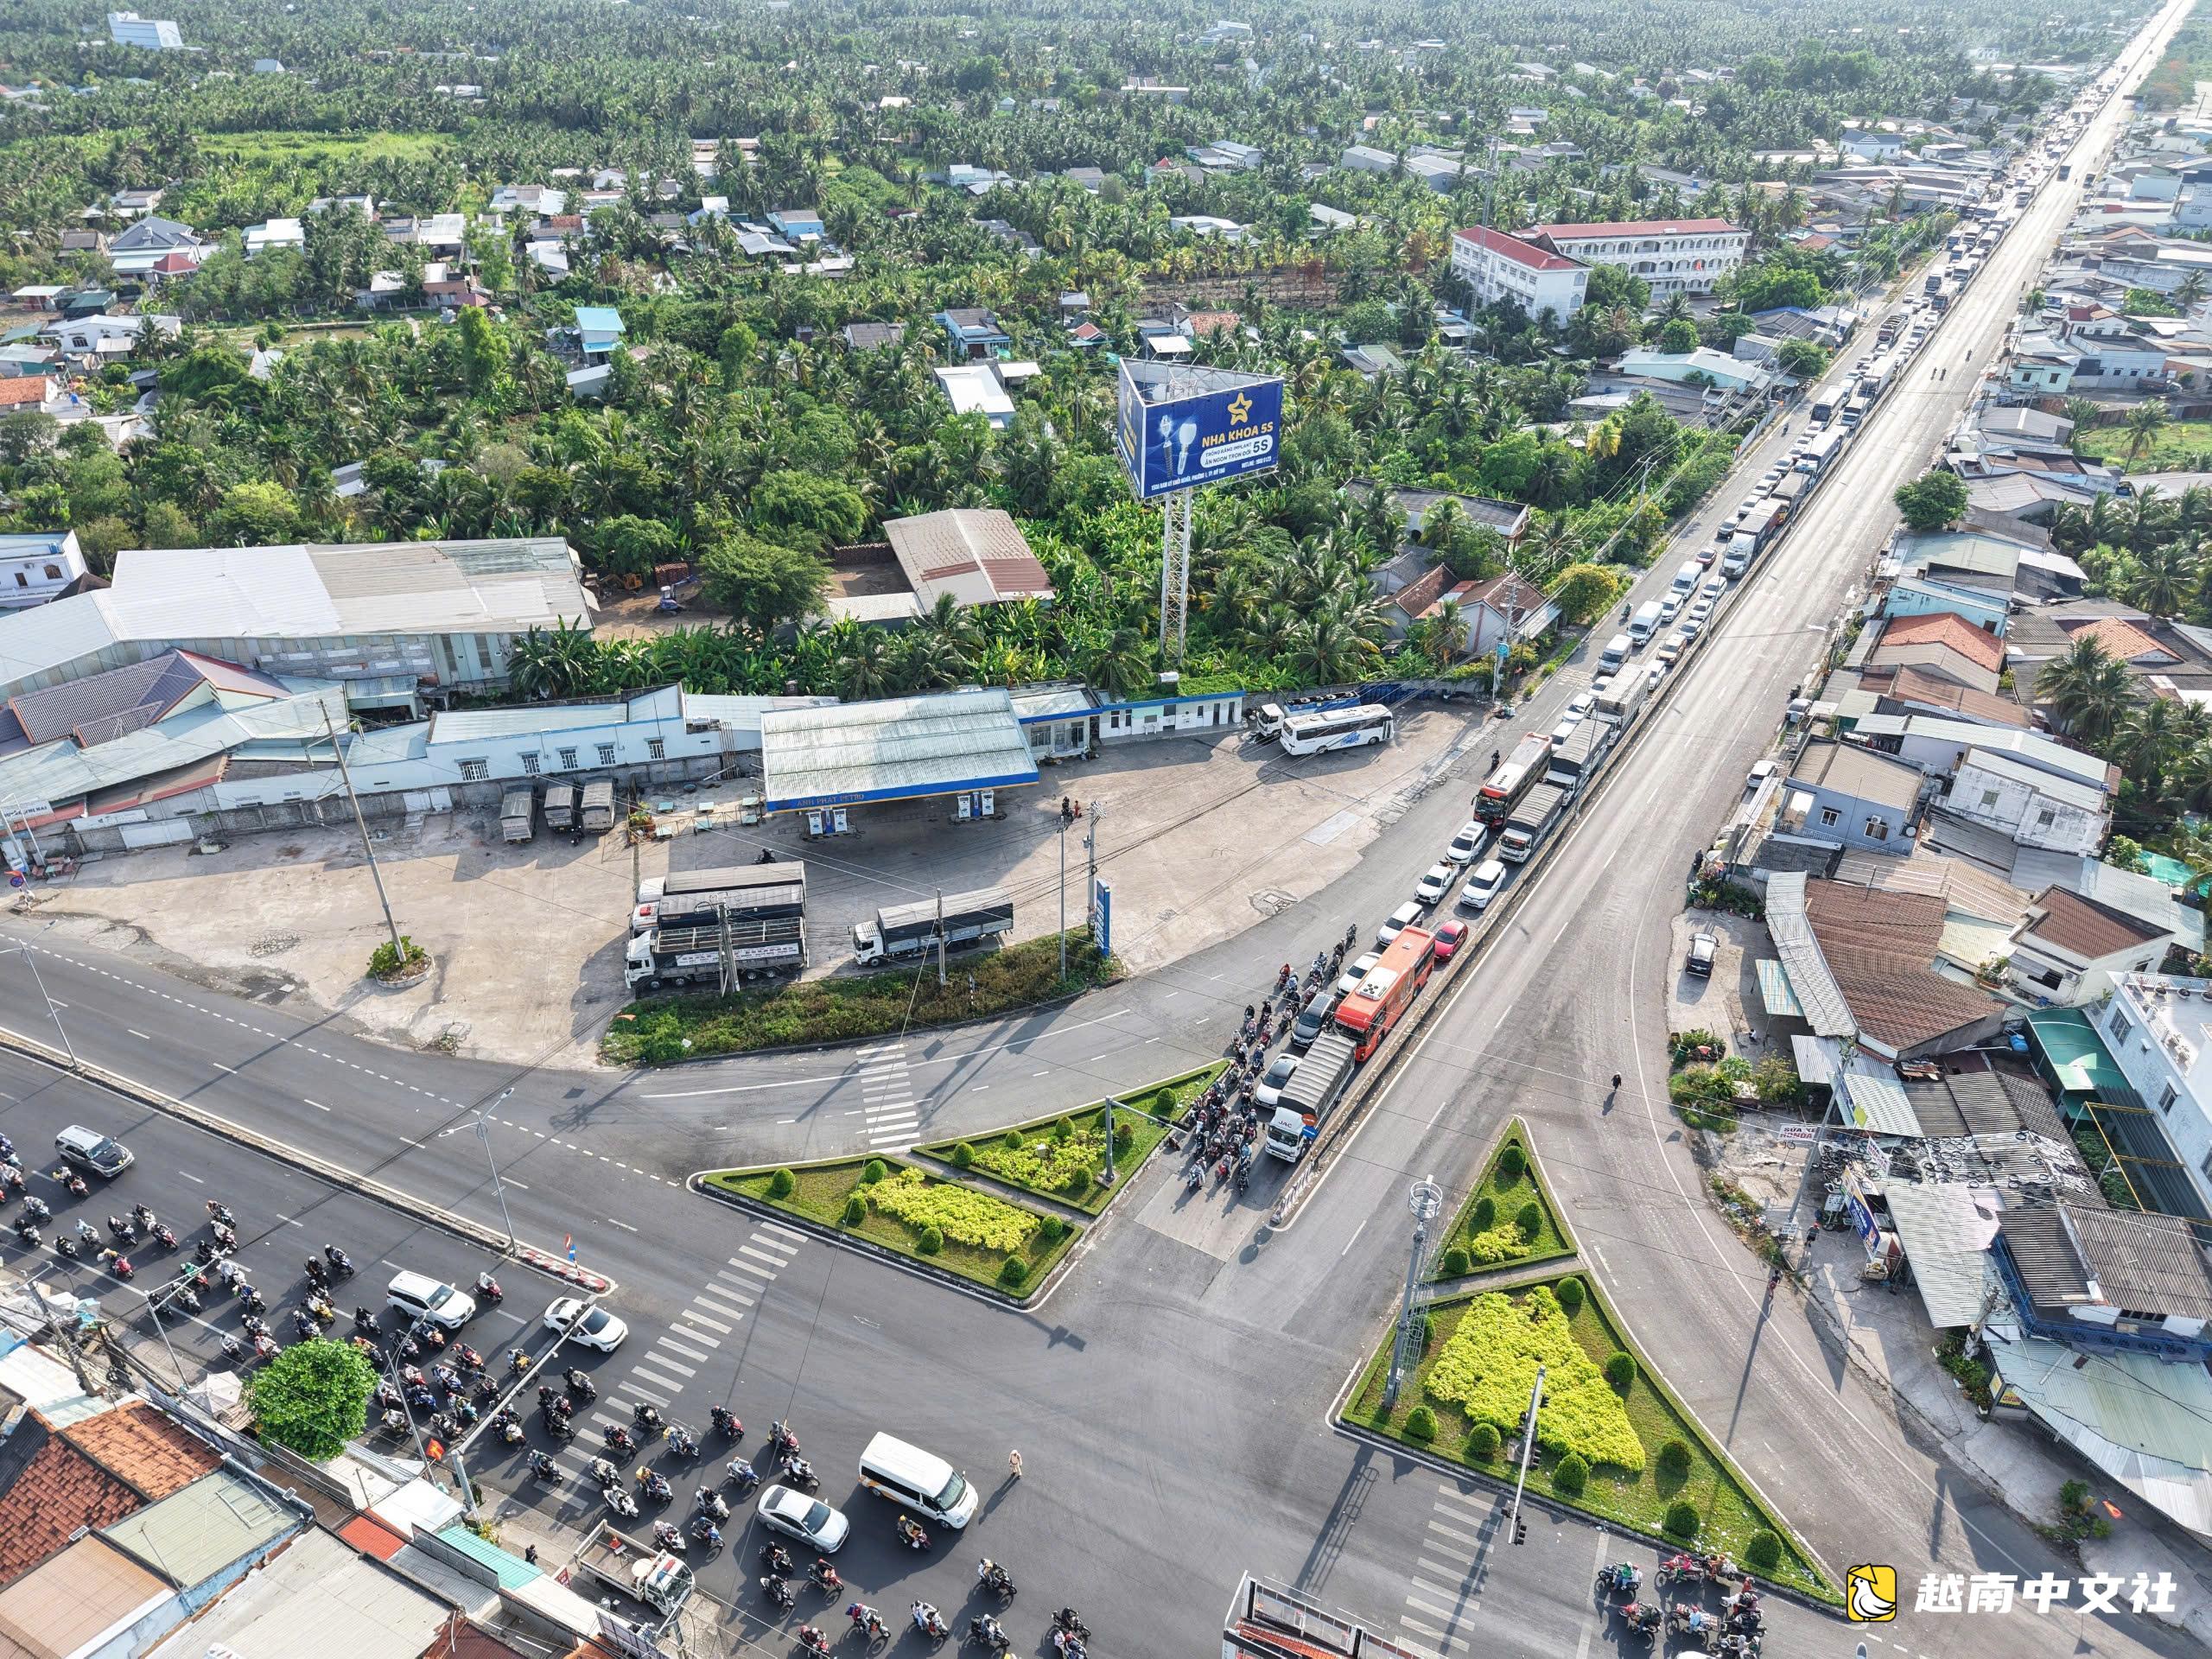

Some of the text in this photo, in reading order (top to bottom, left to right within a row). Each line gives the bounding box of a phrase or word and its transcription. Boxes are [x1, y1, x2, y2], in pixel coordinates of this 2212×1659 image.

[1202, 421, 1274, 448] NHA KHOA 5S
[1253, 439, 1268, 454] 5S
[1213, 455, 1228, 464] NGON
